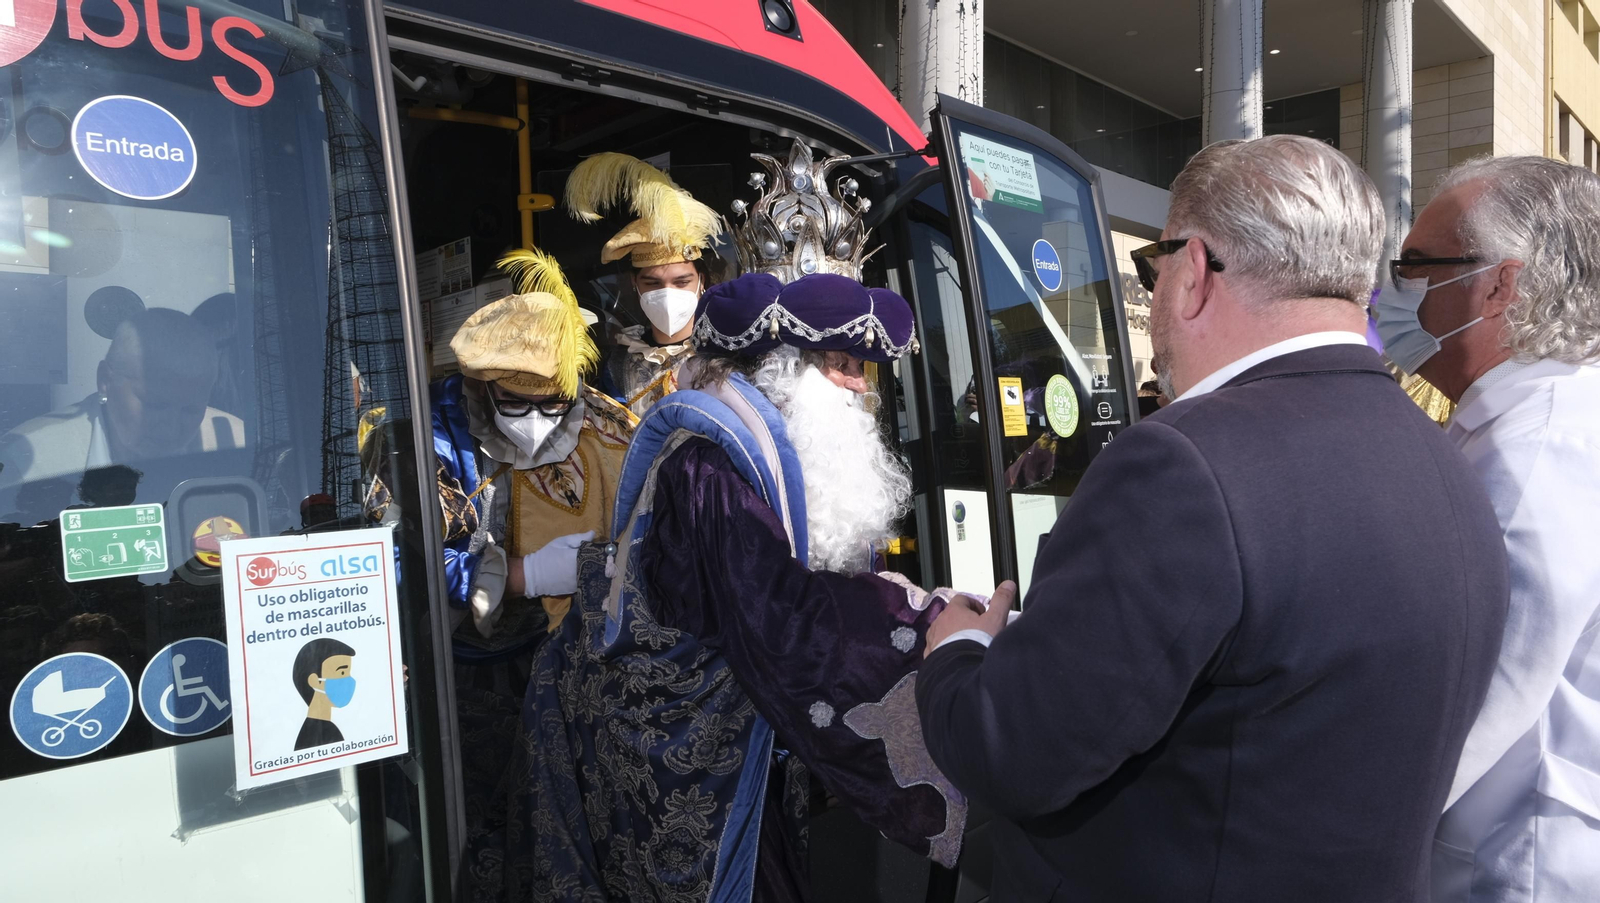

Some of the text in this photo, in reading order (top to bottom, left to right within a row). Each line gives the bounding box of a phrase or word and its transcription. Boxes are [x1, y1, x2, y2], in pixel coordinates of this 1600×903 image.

[85, 131, 185, 163] Entrada
[969, 141, 985, 154] Aquí
[986, 147, 1011, 162] puedes
[988, 161, 1033, 180] con tu Tarjeta
[1035, 258, 1059, 272] Entrada
[1053, 394, 1072, 409] 99%
[247, 554, 378, 580] Surbús alsa
[257, 583, 369, 607] Uso obligatorio
[265, 601, 367, 624] de mascarillas
[246, 614, 386, 644] dentro del autobús.
[254, 734, 395, 770] Gracias por tu colaboración
